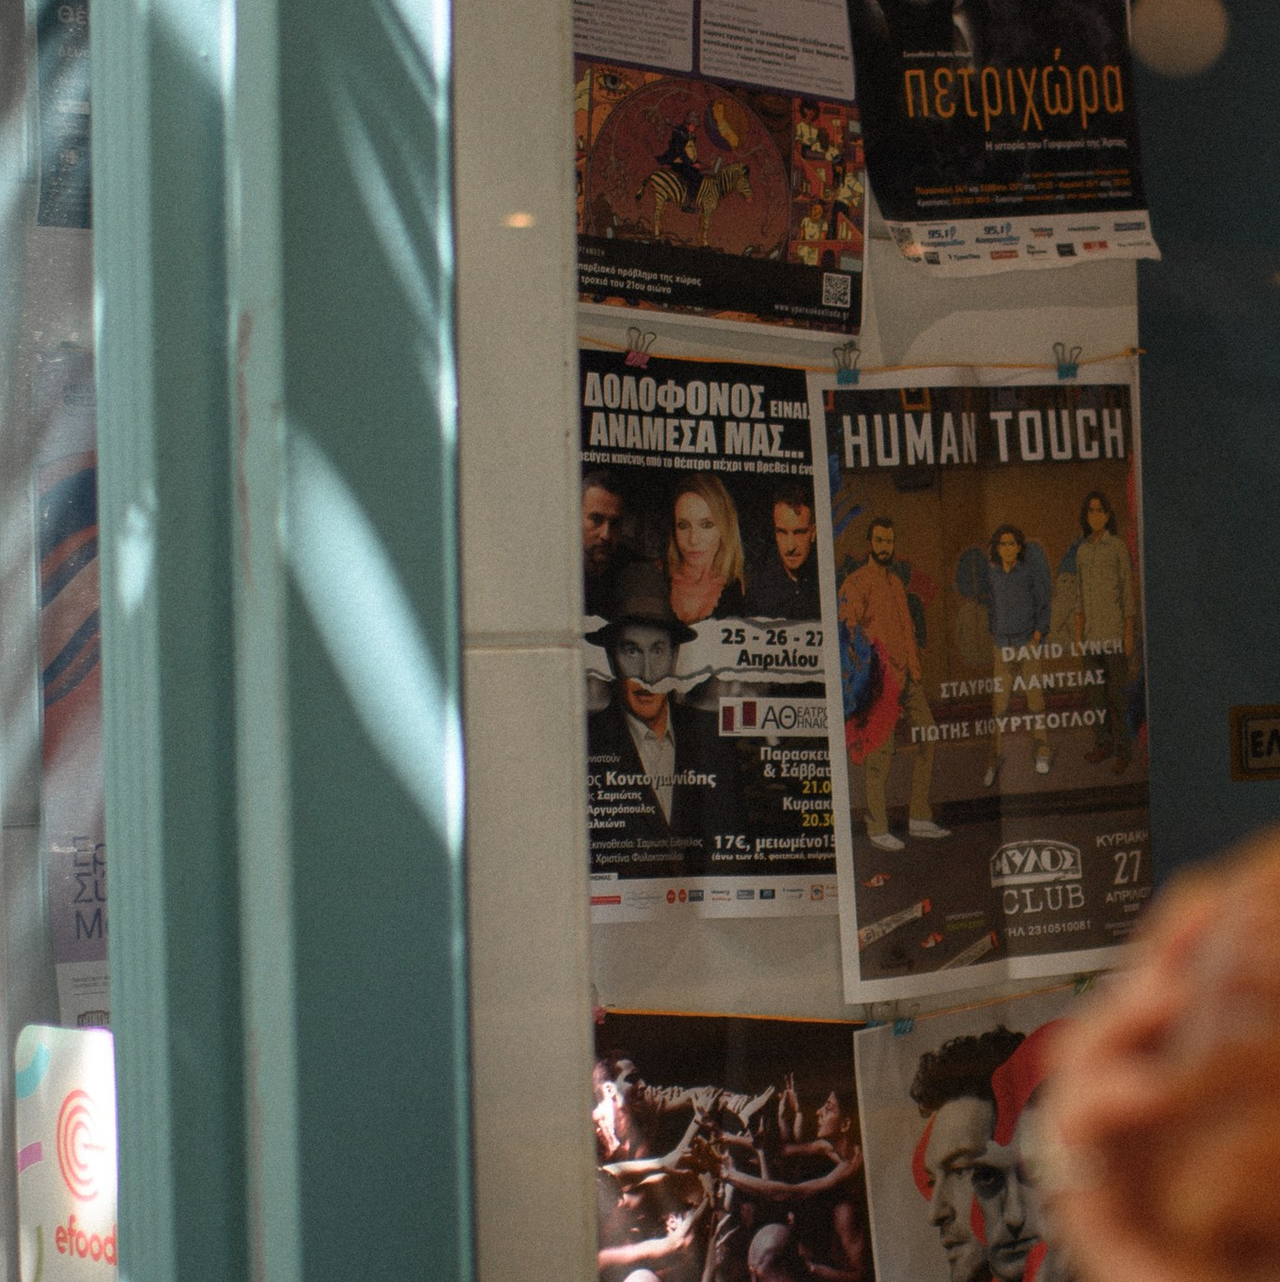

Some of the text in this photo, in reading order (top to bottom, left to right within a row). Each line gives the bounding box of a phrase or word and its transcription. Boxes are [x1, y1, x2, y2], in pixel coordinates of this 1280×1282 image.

[904, 47, 1125, 133] πετριχώρα
[578, 262, 616, 275] παρξιακό
[583, 371, 766, 420] ΔΟΛΟΦΟΝΟΣ
[588, 411, 805, 459] ΑΝΑΜΕΣΑ ΜΑΣ...
[841, 408, 1126, 469] HUMAN TOUCH
[721, 628, 746, 645] 25
[766, 629, 788, 646] 26
[805, 630, 824, 647] 27
[736, 649, 819, 670] Απριλίου
[1001, 638, 1124, 663] DAVID LYNCH
[940, 668, 1107, 699] ΣΤΑΥΡΟΣ ΛΑΝΤΣΙΑΣ
[911, 708, 1108, 744] ΓΙΩΤΗΣ ΚΙΟΥΡΤΣΟΓΛΟΥ
[587, 752, 621, 763] νιστούν
[605, 769, 717, 790] Κοντογιαννίδης
[763, 764, 776, 778] &
[597, 790, 642, 803] Σαμιώτης
[589, 818, 626, 830] αλκώνη
[714, 834, 751, 852] 17€,
[1113, 850, 1142, 886] 27
[1002, 884, 1085, 916] CLUB
[55, 1213, 118, 1266] efood
